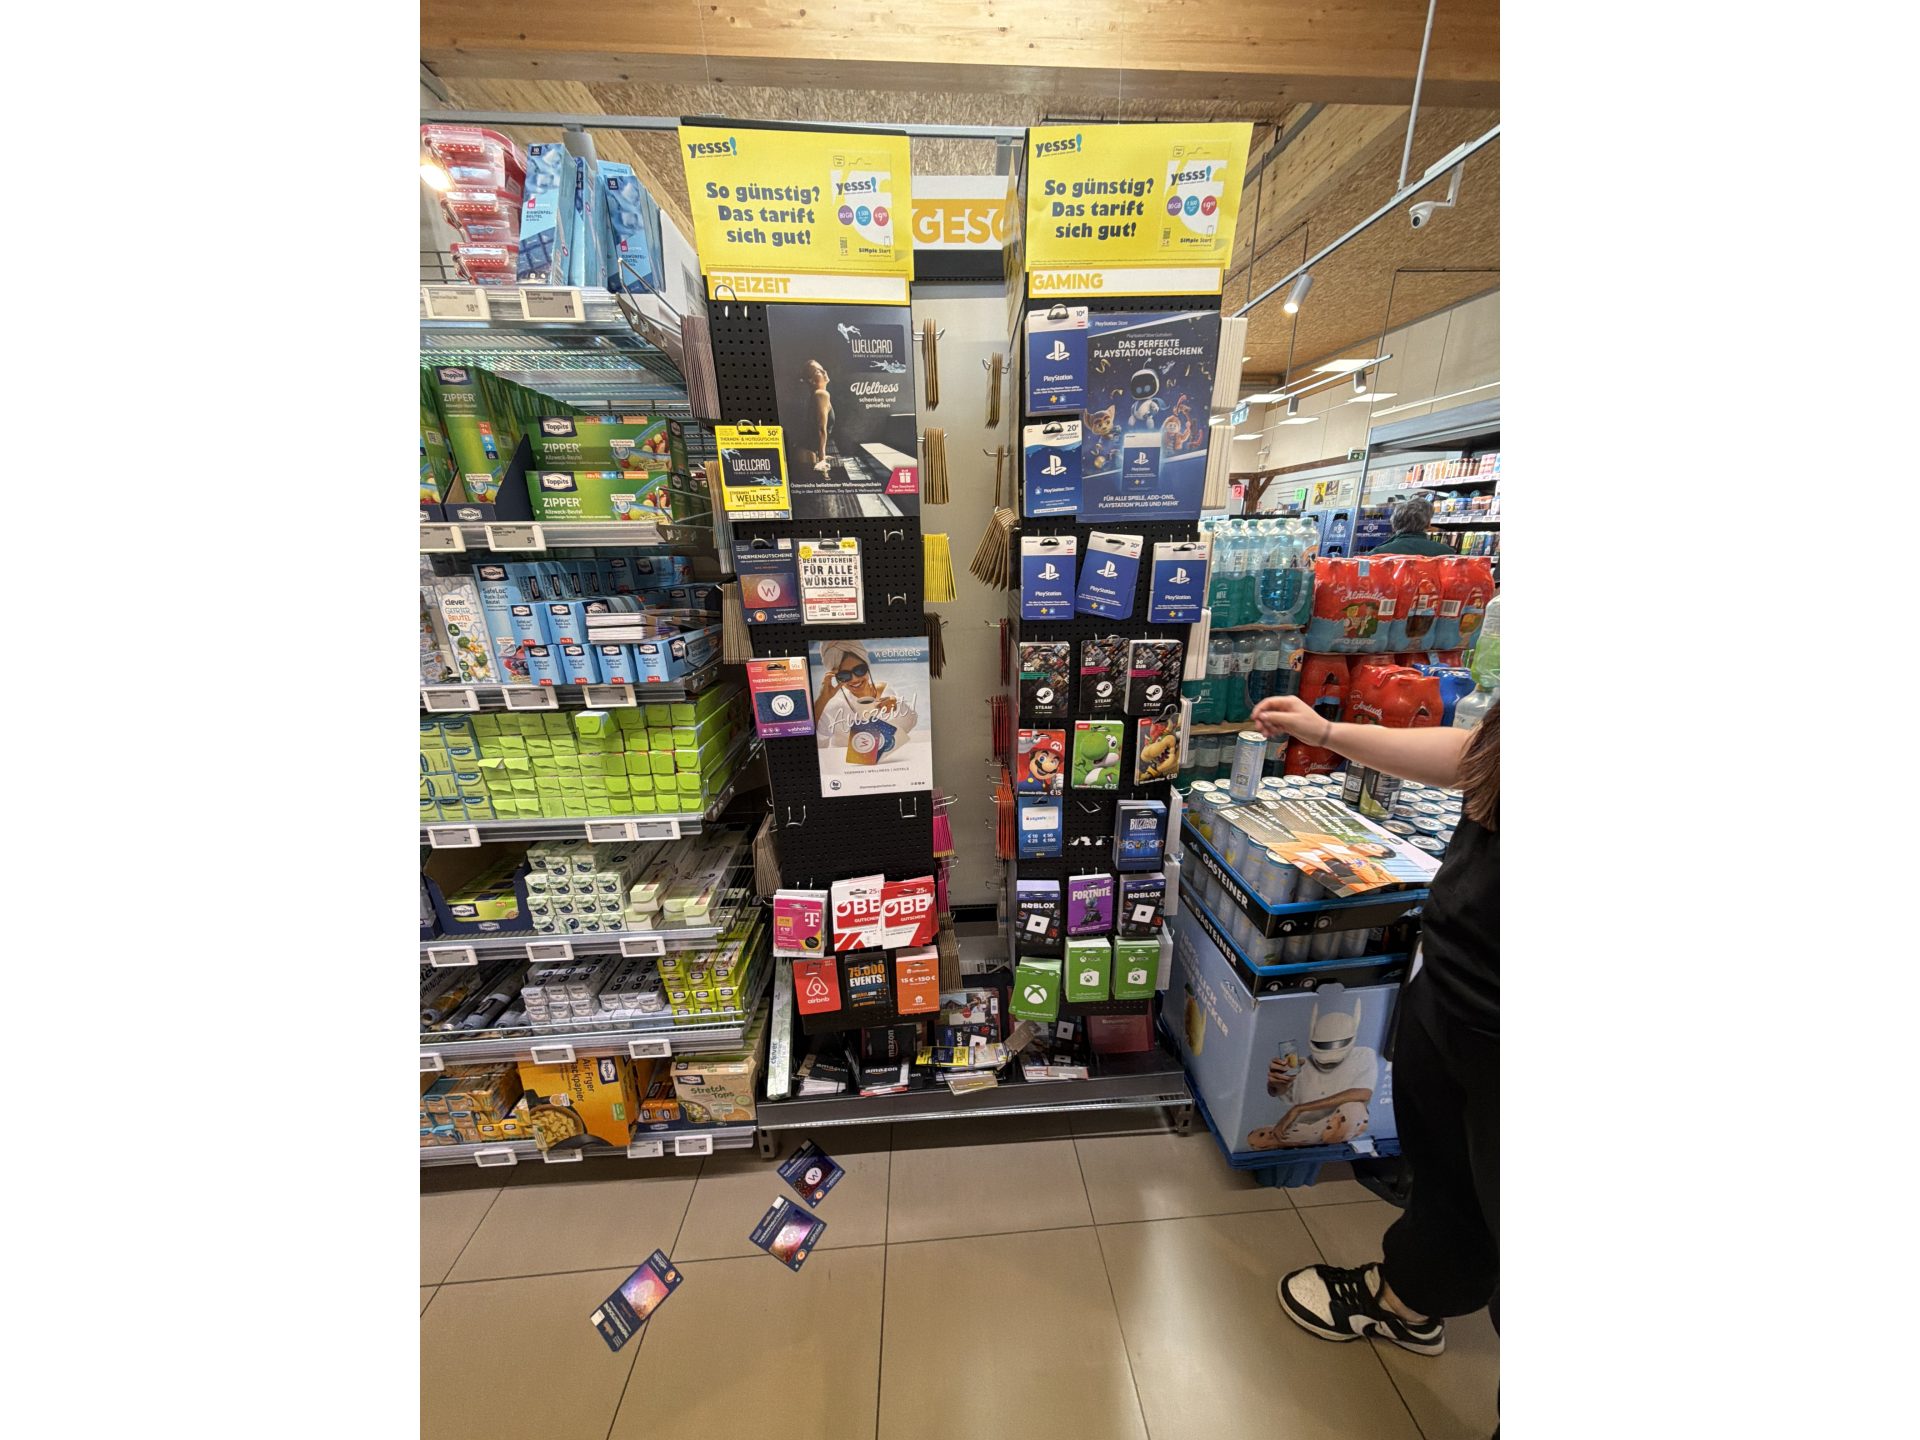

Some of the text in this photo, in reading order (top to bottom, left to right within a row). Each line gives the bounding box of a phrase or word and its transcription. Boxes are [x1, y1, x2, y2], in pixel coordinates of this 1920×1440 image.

[687, 136, 737, 158] yesss!
[1035, 133, 1082, 158] yesss!
[1171, 165, 1212, 186] yesss!
[836, 176, 877, 195] yesss!
[1044, 177, 1154, 197] So günstig?
[706, 182, 820, 204] So günstig?
[718, 205, 815, 224] Das tarift
[1052, 200, 1144, 217] Das tarift
[1056, 222, 1137, 240] sich gut!
[726, 229, 811, 247] sich gut!
[711, 276, 790, 294] FREIZEIT
[1033, 273, 1103, 290] GAMING
[851, 339, 893, 354] WELLCARD
[1118, 339, 1180, 349] DAS PERFEKTE
[1094, 347, 1204, 358] PLAYSTATION-GESCHENK
[443, 371, 465, 379] Toppits
[1043, 374, 1074, 382] PlayStation
[850, 381, 899, 395] Wellness
[442, 393, 475, 402] ZIPPER
[546, 423, 569, 432] Toppits
[542, 443, 579, 453] ZIPPER
[732, 458, 771, 471] WELLCARD
[546, 478, 569, 487] Toppits
[542, 497, 579, 508] ZIPPER
[736, 494, 776, 502] WELLNESS
[803, 565, 853, 575] FÜR ALLE
[804, 576, 854, 586] WÜNSCHE
[1089, 585, 1116, 596] PlayStation
[874, 647, 921, 658] webhotels
[827, 692, 918, 733] Auszeit!
[1129, 818, 1158, 831] BLIZZARD
[1202, 853, 1249, 909] GASTEINER
[1072, 886, 1111, 901] FORTNITE
[1127, 891, 1161, 899] ROBLOX
[1194, 908, 1238, 967] GASTEINER
[848, 963, 885, 977] 75.000
[849, 974, 886, 987] EVENTS!
[807, 996, 830, 1004] airbnb
[770, 1042, 778, 1065] clever
[583, 1058, 594, 1093] Air Fryer
[865, 1066, 898, 1074] amazon
[690, 1085, 726, 1094] Stretch
[711, 1091, 735, 1099] Tops
